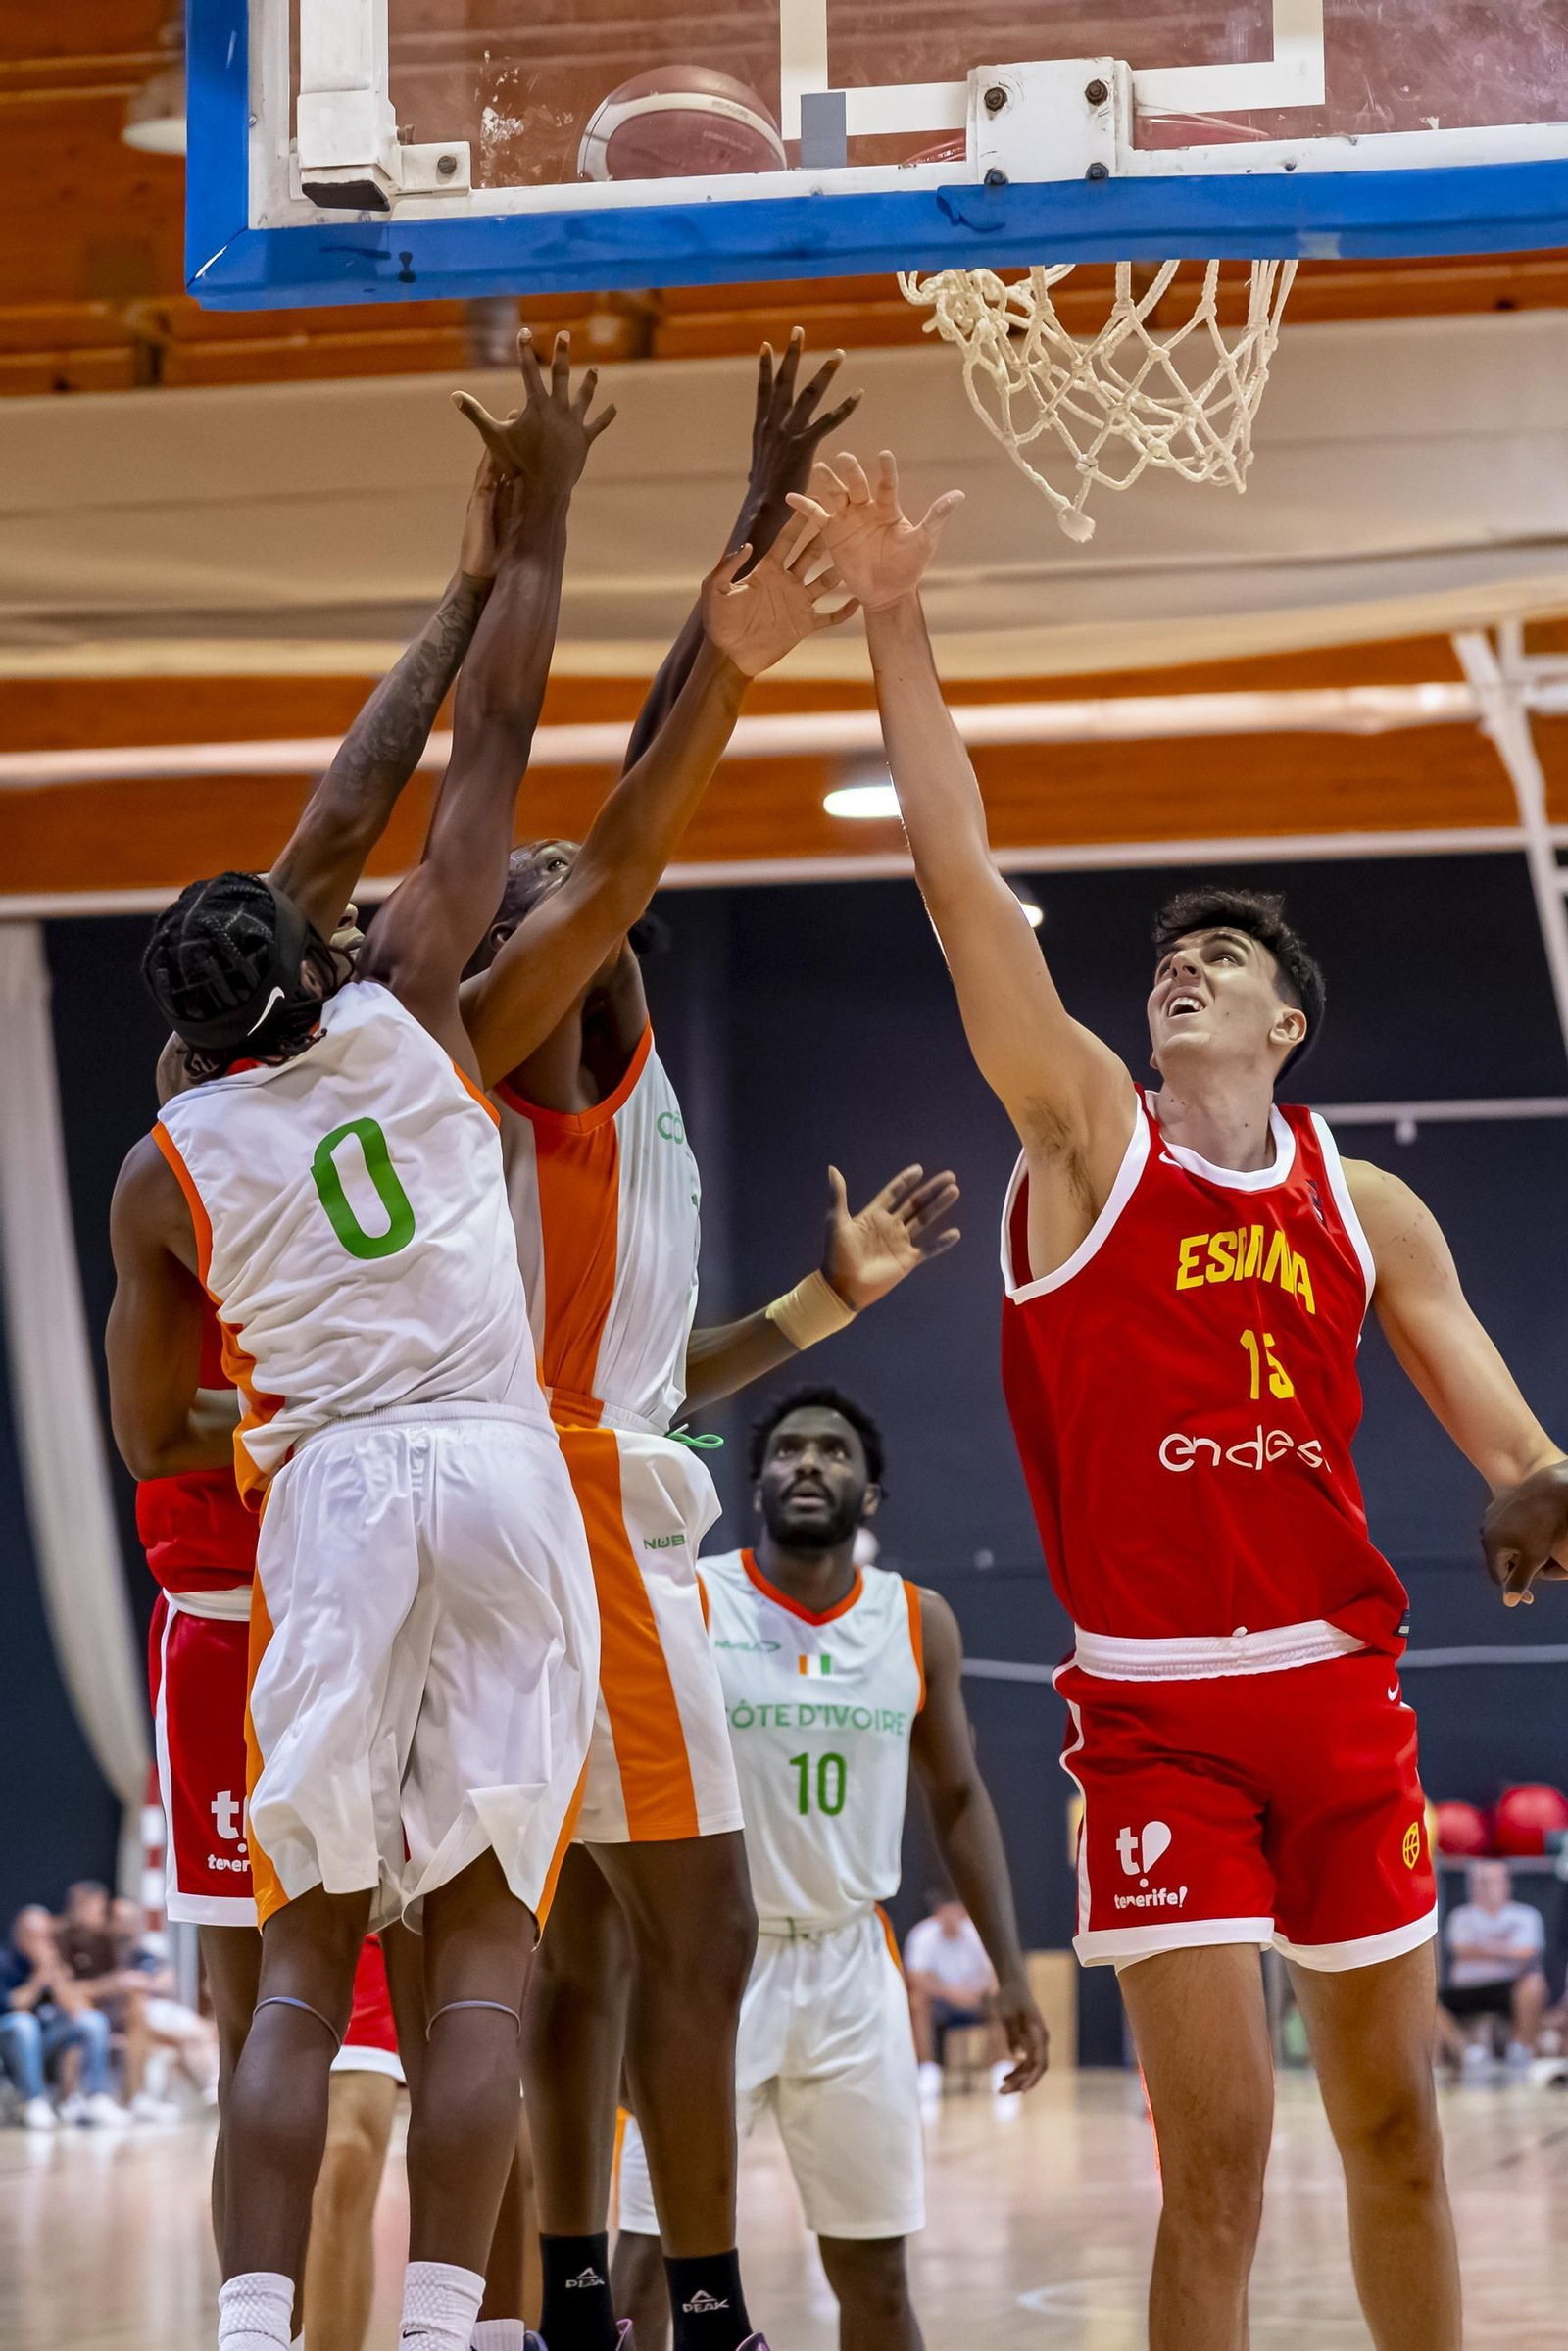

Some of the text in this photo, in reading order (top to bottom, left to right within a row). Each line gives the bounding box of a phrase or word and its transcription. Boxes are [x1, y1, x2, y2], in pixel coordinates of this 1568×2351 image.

[310, 1116, 416, 1260] 0
[1240, 1329, 1295, 1400] 15
[1158, 1424, 1332, 1472] endes
[725, 1699, 791, 1729] ÔTE
[789, 1752, 847, 1817] 10
